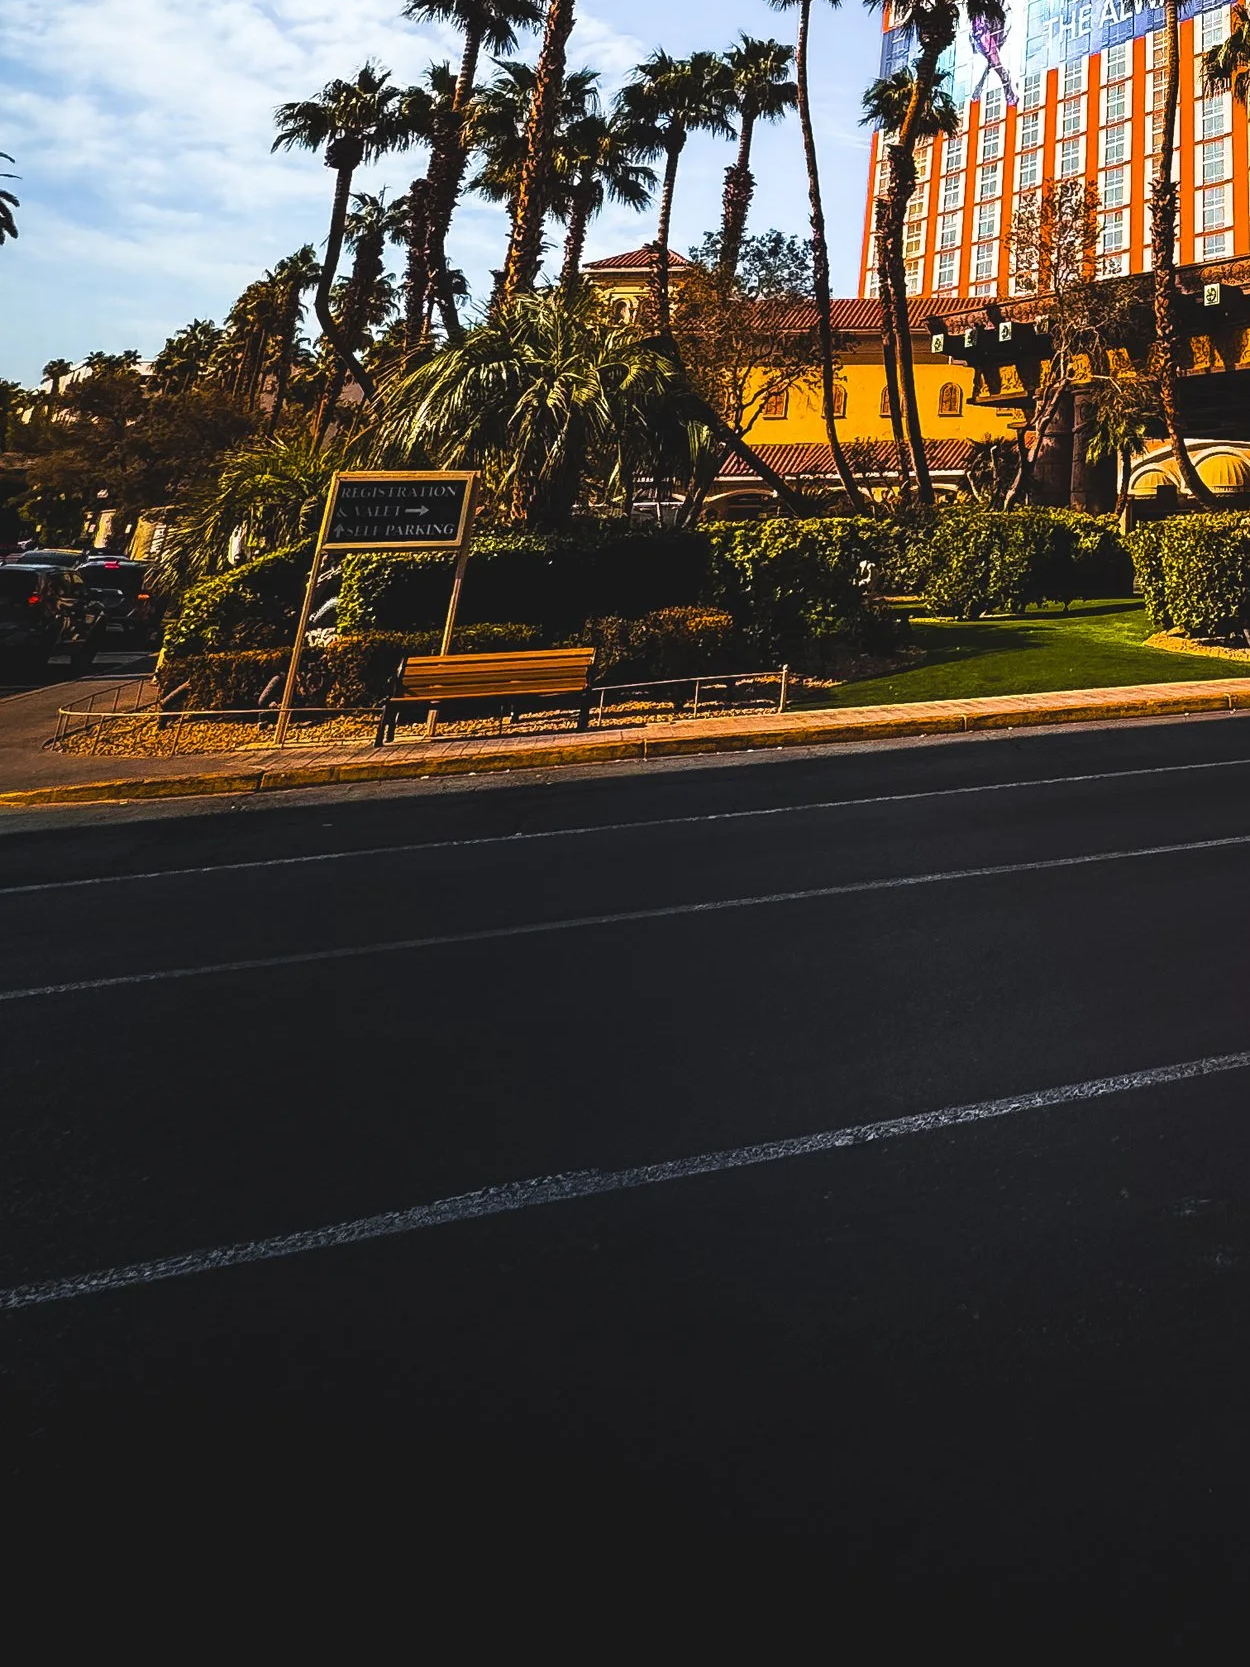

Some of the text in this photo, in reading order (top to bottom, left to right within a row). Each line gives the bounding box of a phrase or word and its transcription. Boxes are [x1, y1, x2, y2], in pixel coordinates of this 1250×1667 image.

[1043, 3, 1092, 50] THE
[341, 486, 457, 499] REGISTRATION
[336, 506, 403, 518] & VALET
[346, 523, 456, 537] SELF PARKING
